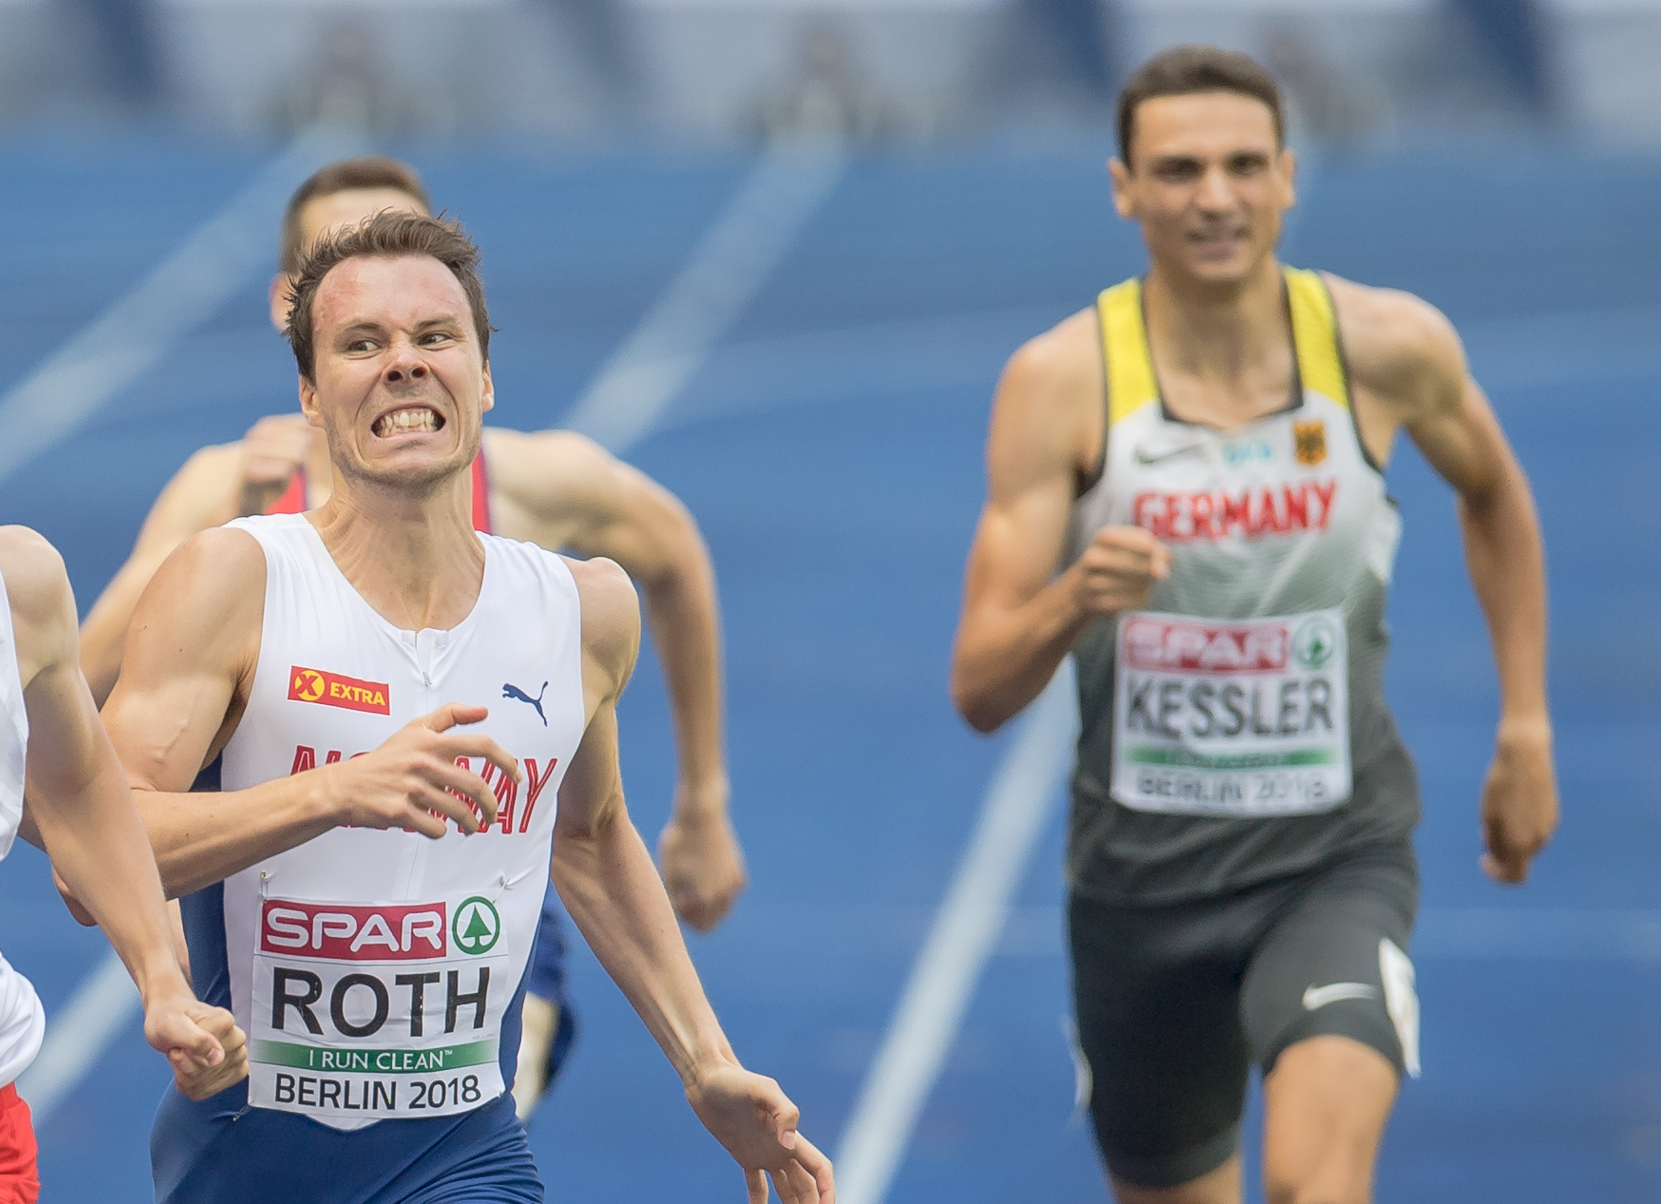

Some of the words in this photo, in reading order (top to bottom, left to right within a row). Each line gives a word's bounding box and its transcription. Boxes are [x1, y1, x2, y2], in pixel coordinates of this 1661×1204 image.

[1133, 478, 1337, 542] GERMANY
[330, 682, 386, 706] EXTRA
[1127, 680, 1334, 740] KESSLER
[266, 908, 443, 952] SPAR
[271, 966, 491, 1037] ROTH
[309, 1049, 314, 1067] I
[322, 1050, 371, 1069] RUN
[275, 1073, 397, 1110] BERLIN
[409, 1074, 482, 1109] 2018
